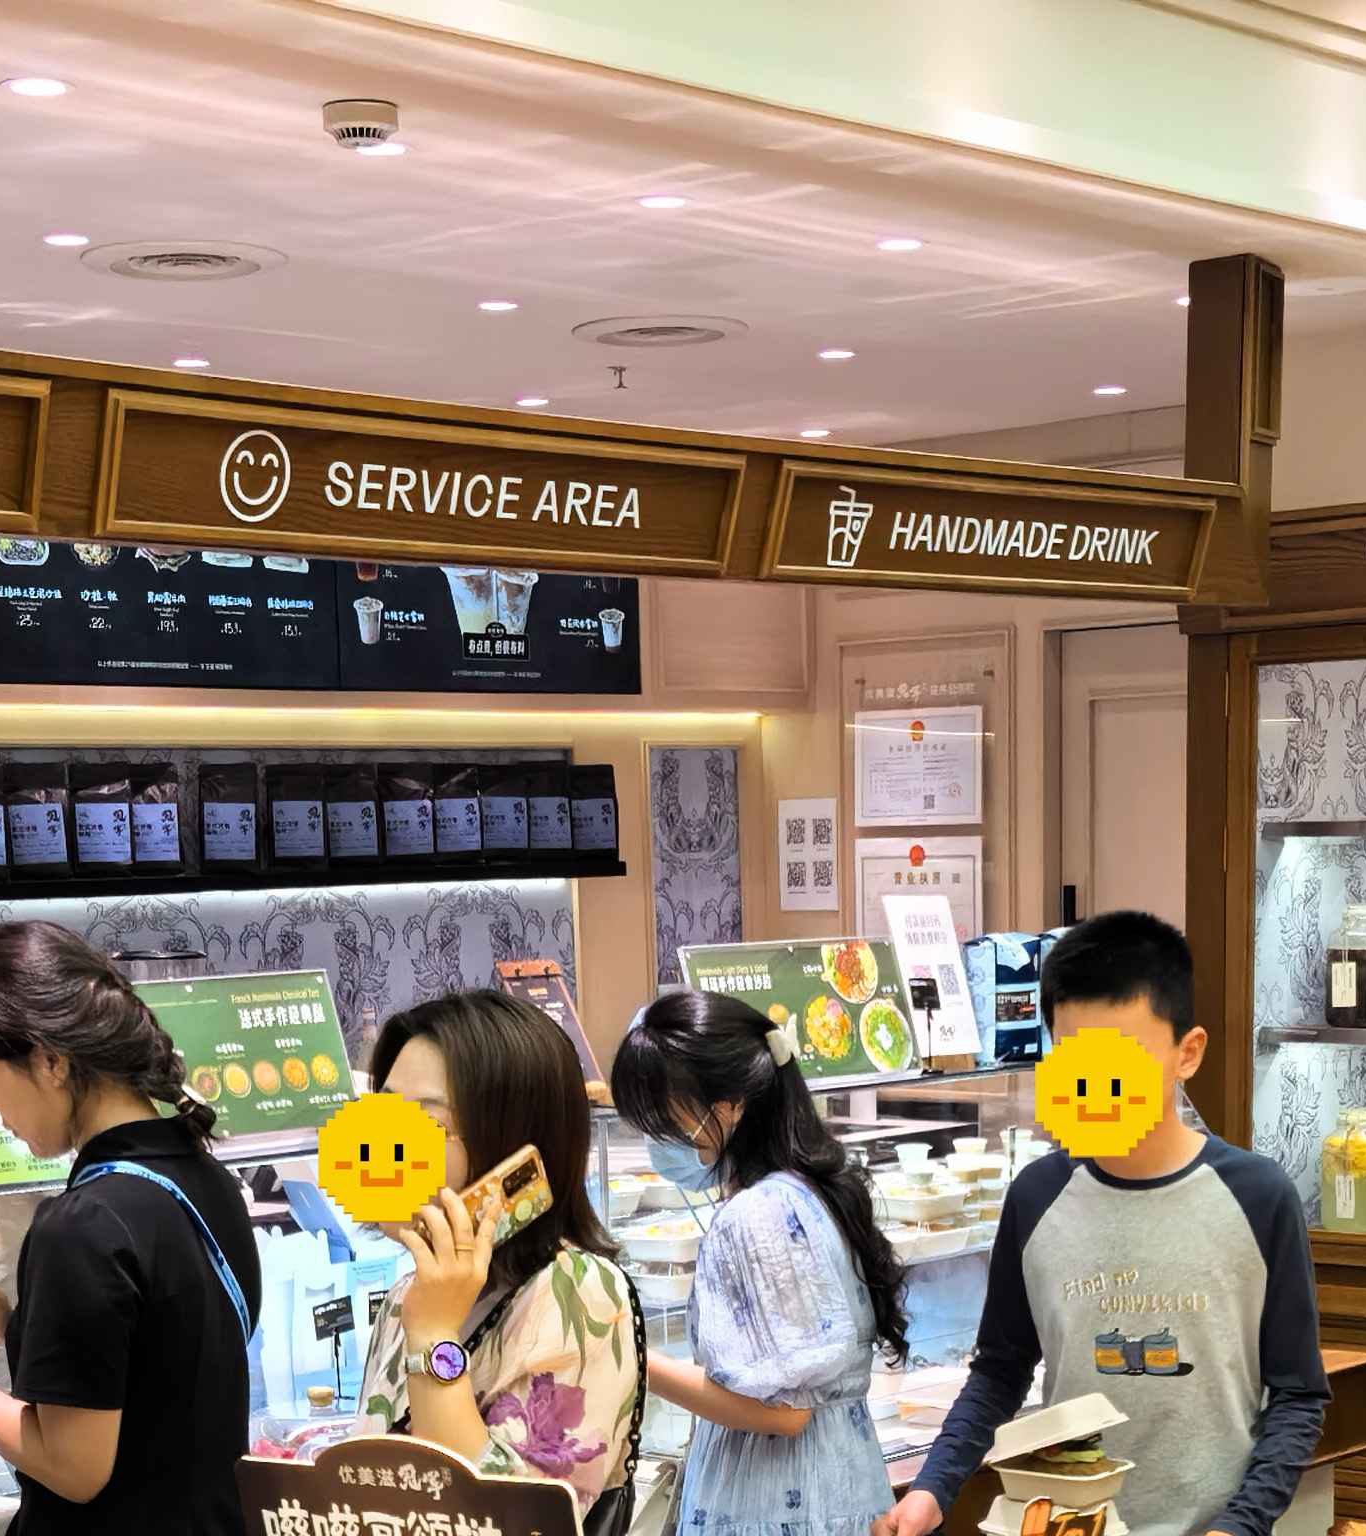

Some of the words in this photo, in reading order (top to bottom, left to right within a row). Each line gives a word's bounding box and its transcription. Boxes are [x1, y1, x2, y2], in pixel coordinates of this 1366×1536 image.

[324, 460, 519, 519] SERVICE
[532, 480, 641, 529] AREA
[888, 510, 1065, 561] HANDMADE
[1067, 525, 1158, 567] DRINK
